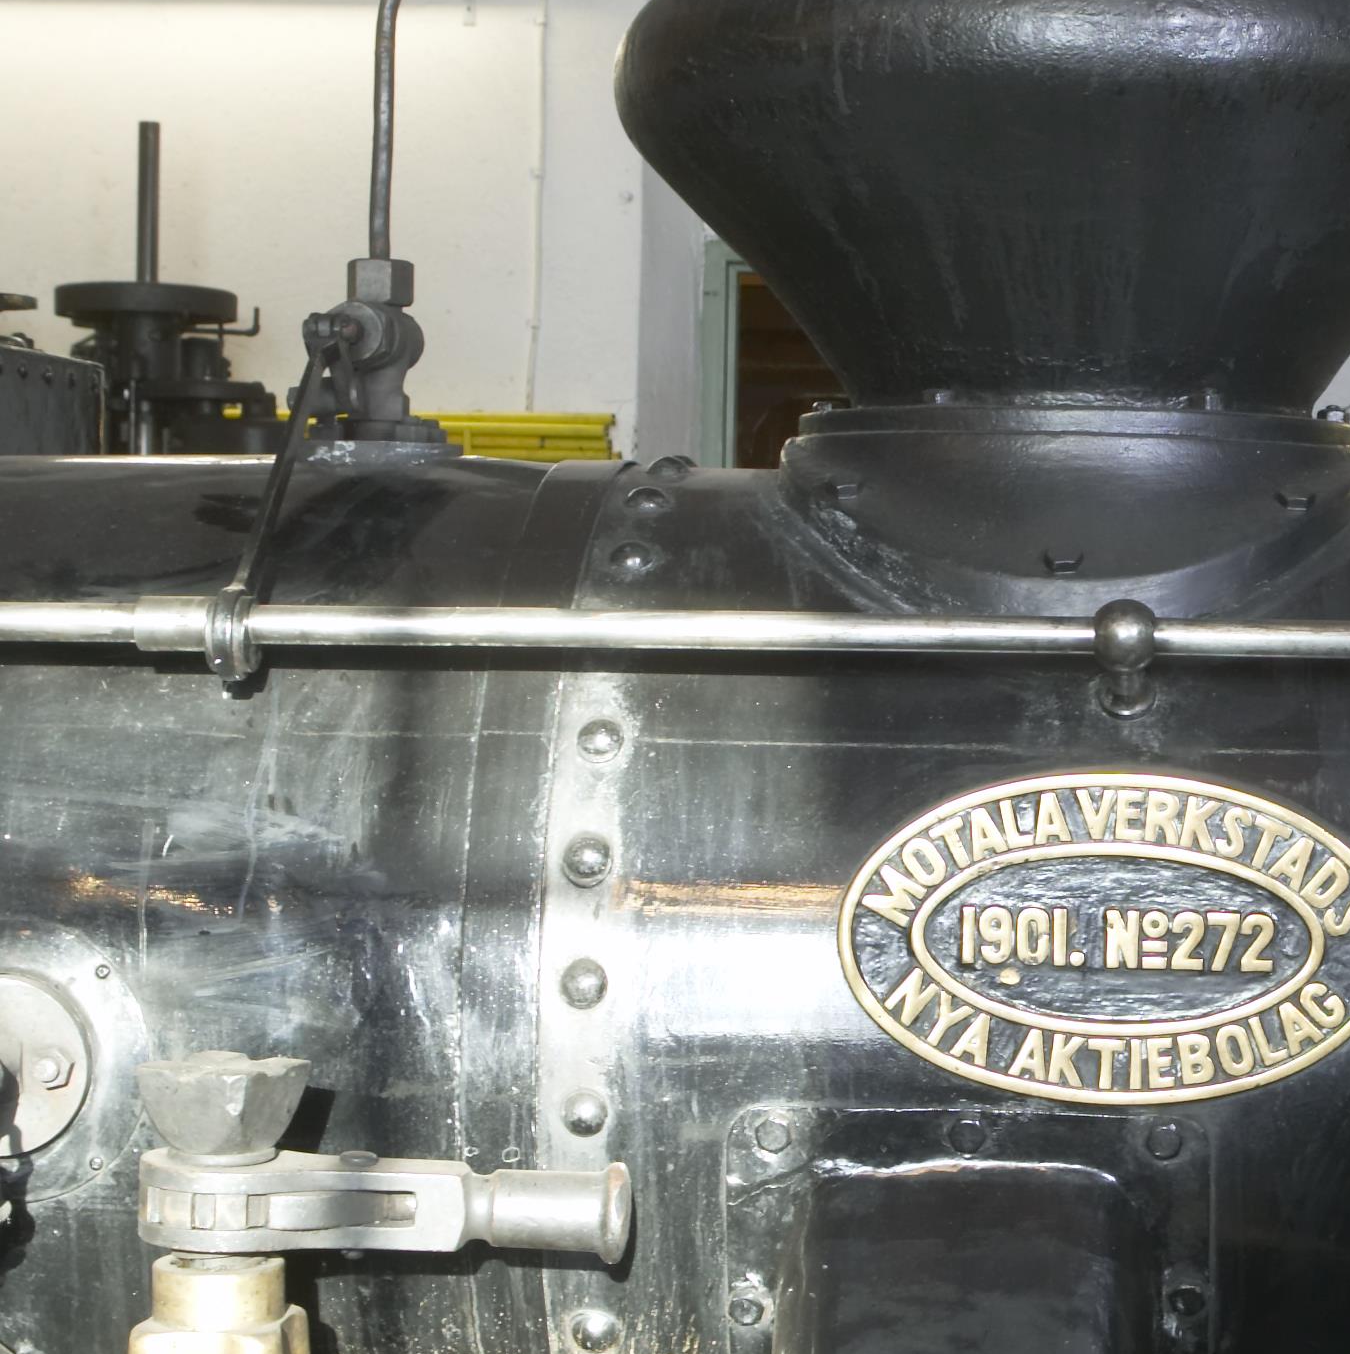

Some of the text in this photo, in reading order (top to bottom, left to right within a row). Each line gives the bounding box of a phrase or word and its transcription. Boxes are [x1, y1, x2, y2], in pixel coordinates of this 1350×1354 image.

[862, 792, 1071, 928] MOTALA
[884, 967, 1346, 1091] NYA AKTIEBOLAG
